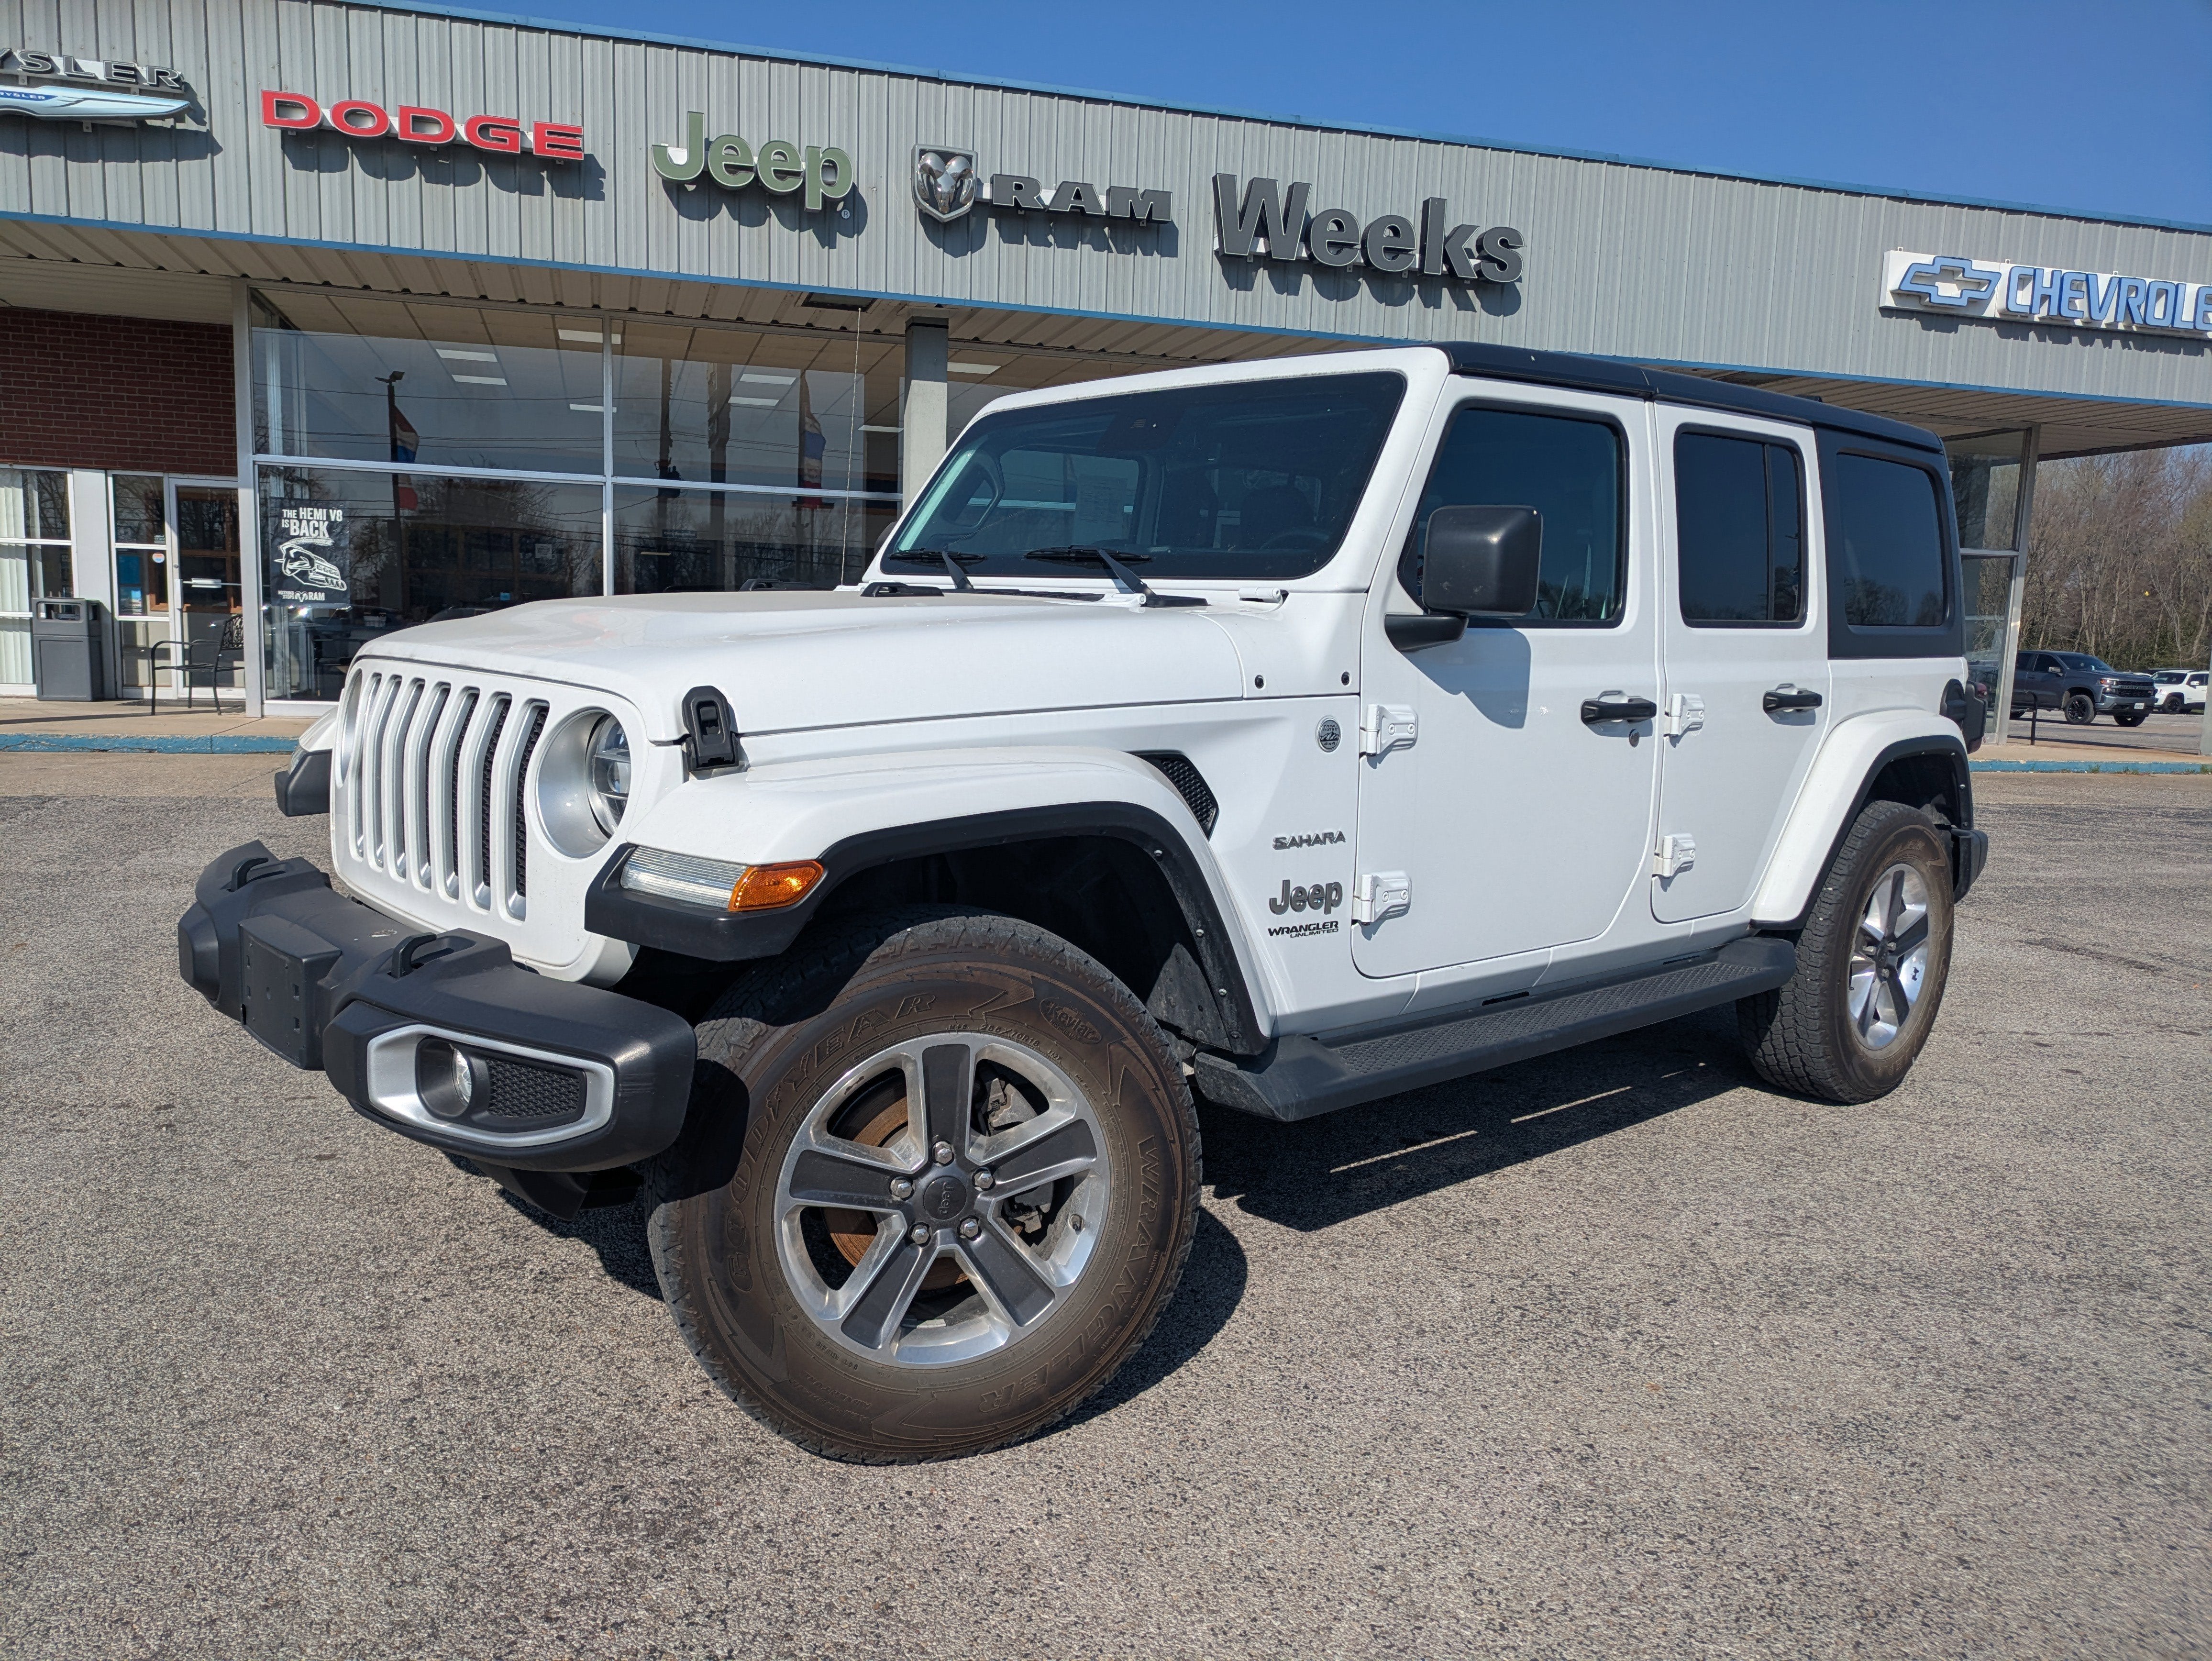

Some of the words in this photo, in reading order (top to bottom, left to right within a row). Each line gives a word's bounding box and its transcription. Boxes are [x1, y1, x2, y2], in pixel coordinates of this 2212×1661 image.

[261, 89, 584, 161] DODGE
[652, 111, 853, 212] Jeep
[990, 173, 1173, 224] RAM
[1212, 173, 1525, 283] Weeks
[282, 509, 297, 518] THE
[299, 507, 327, 520] HEMI
[329, 509, 343, 521] V8
[282, 519, 289, 528] IS
[290, 519, 329, 537] BACK
[309, 592, 325, 601] RAM
[1272, 830, 1346, 850] SAHARA
[1269, 879, 1343, 915] Jeep
[1268, 920, 1338, 936] WRANGLER
[1290, 928, 1339, 938] UNLIMITED
[726, 993, 936, 1292] GOODYEAR
[979, 1134, 1160, 1413] WRANGLER
